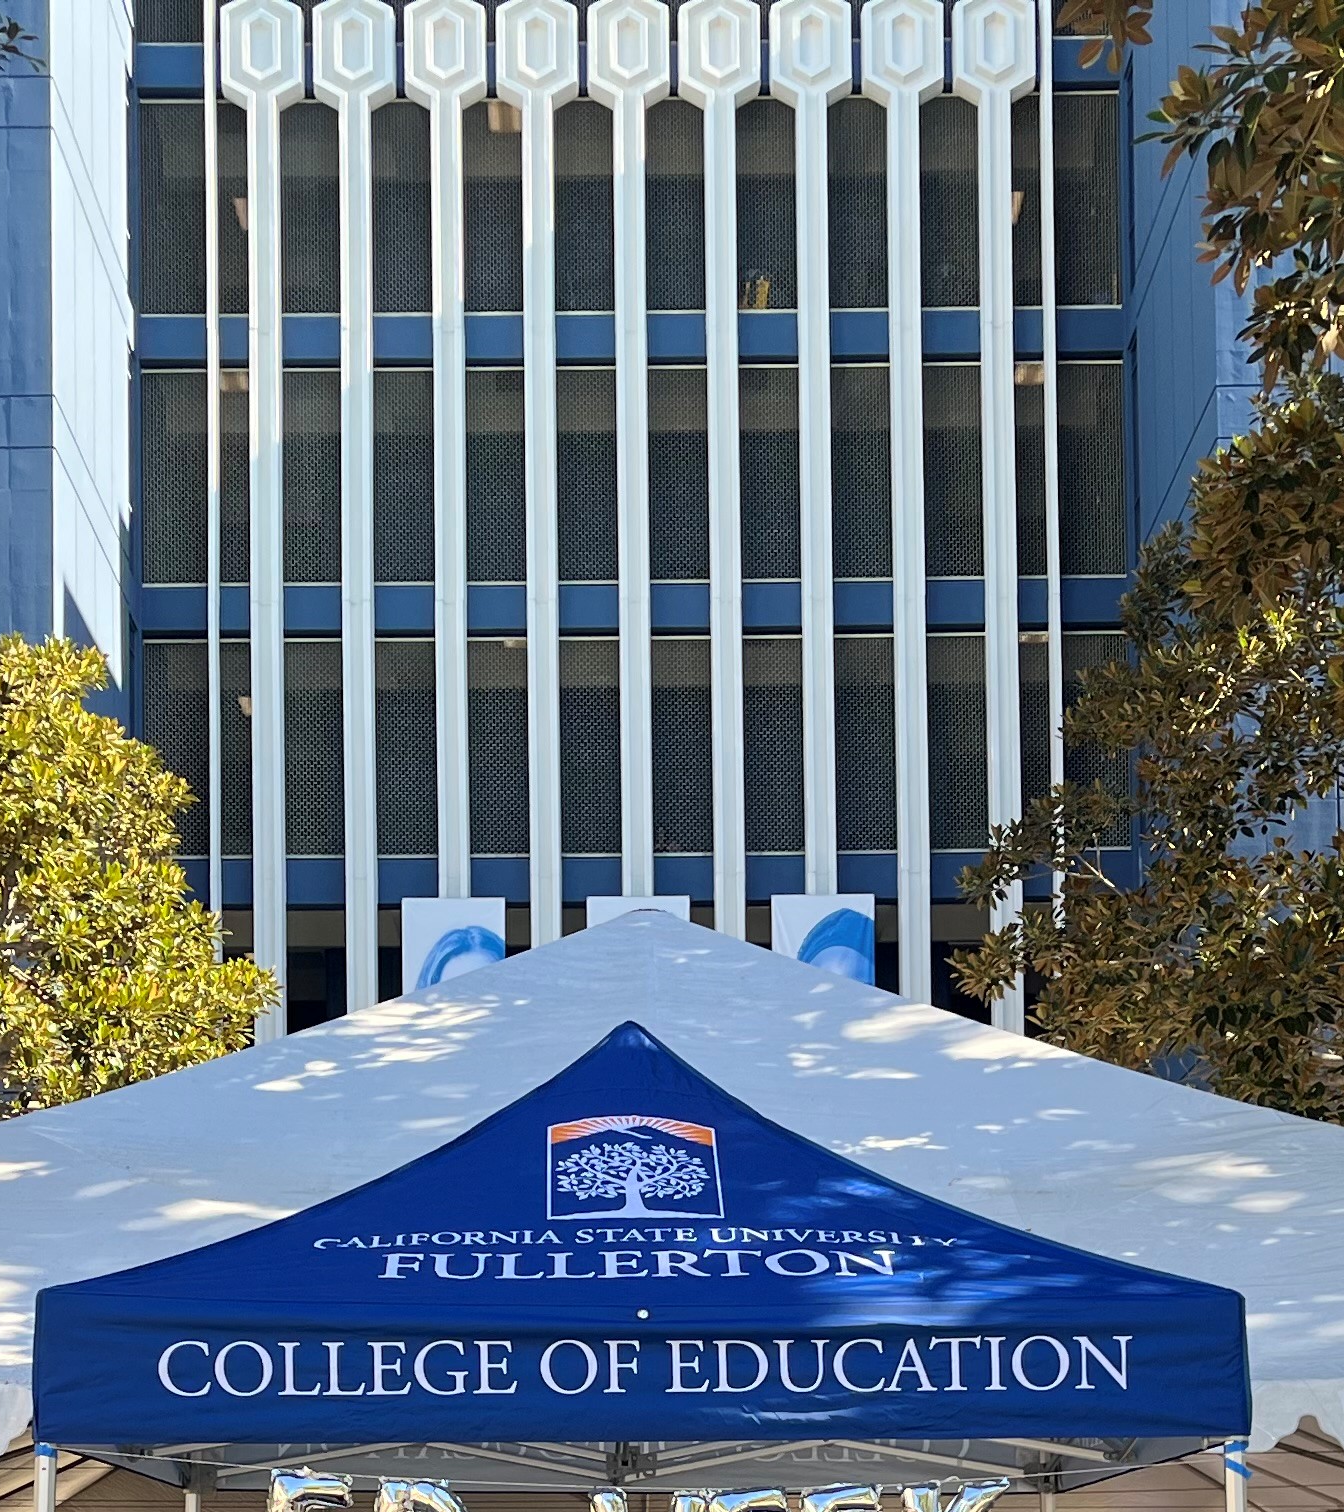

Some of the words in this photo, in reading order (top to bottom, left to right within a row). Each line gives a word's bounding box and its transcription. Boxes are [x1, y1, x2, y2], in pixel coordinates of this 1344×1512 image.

[313, 1229, 564, 1249] CALIFORNIA
[574, 1227, 698, 1244] STATE
[377, 1249, 896, 1279] FULLERTON
[157, 1339, 518, 1398] COLLEGE
[538, 1339, 642, 1396] OF
[664, 1335, 1134, 1394] EDUCATION
